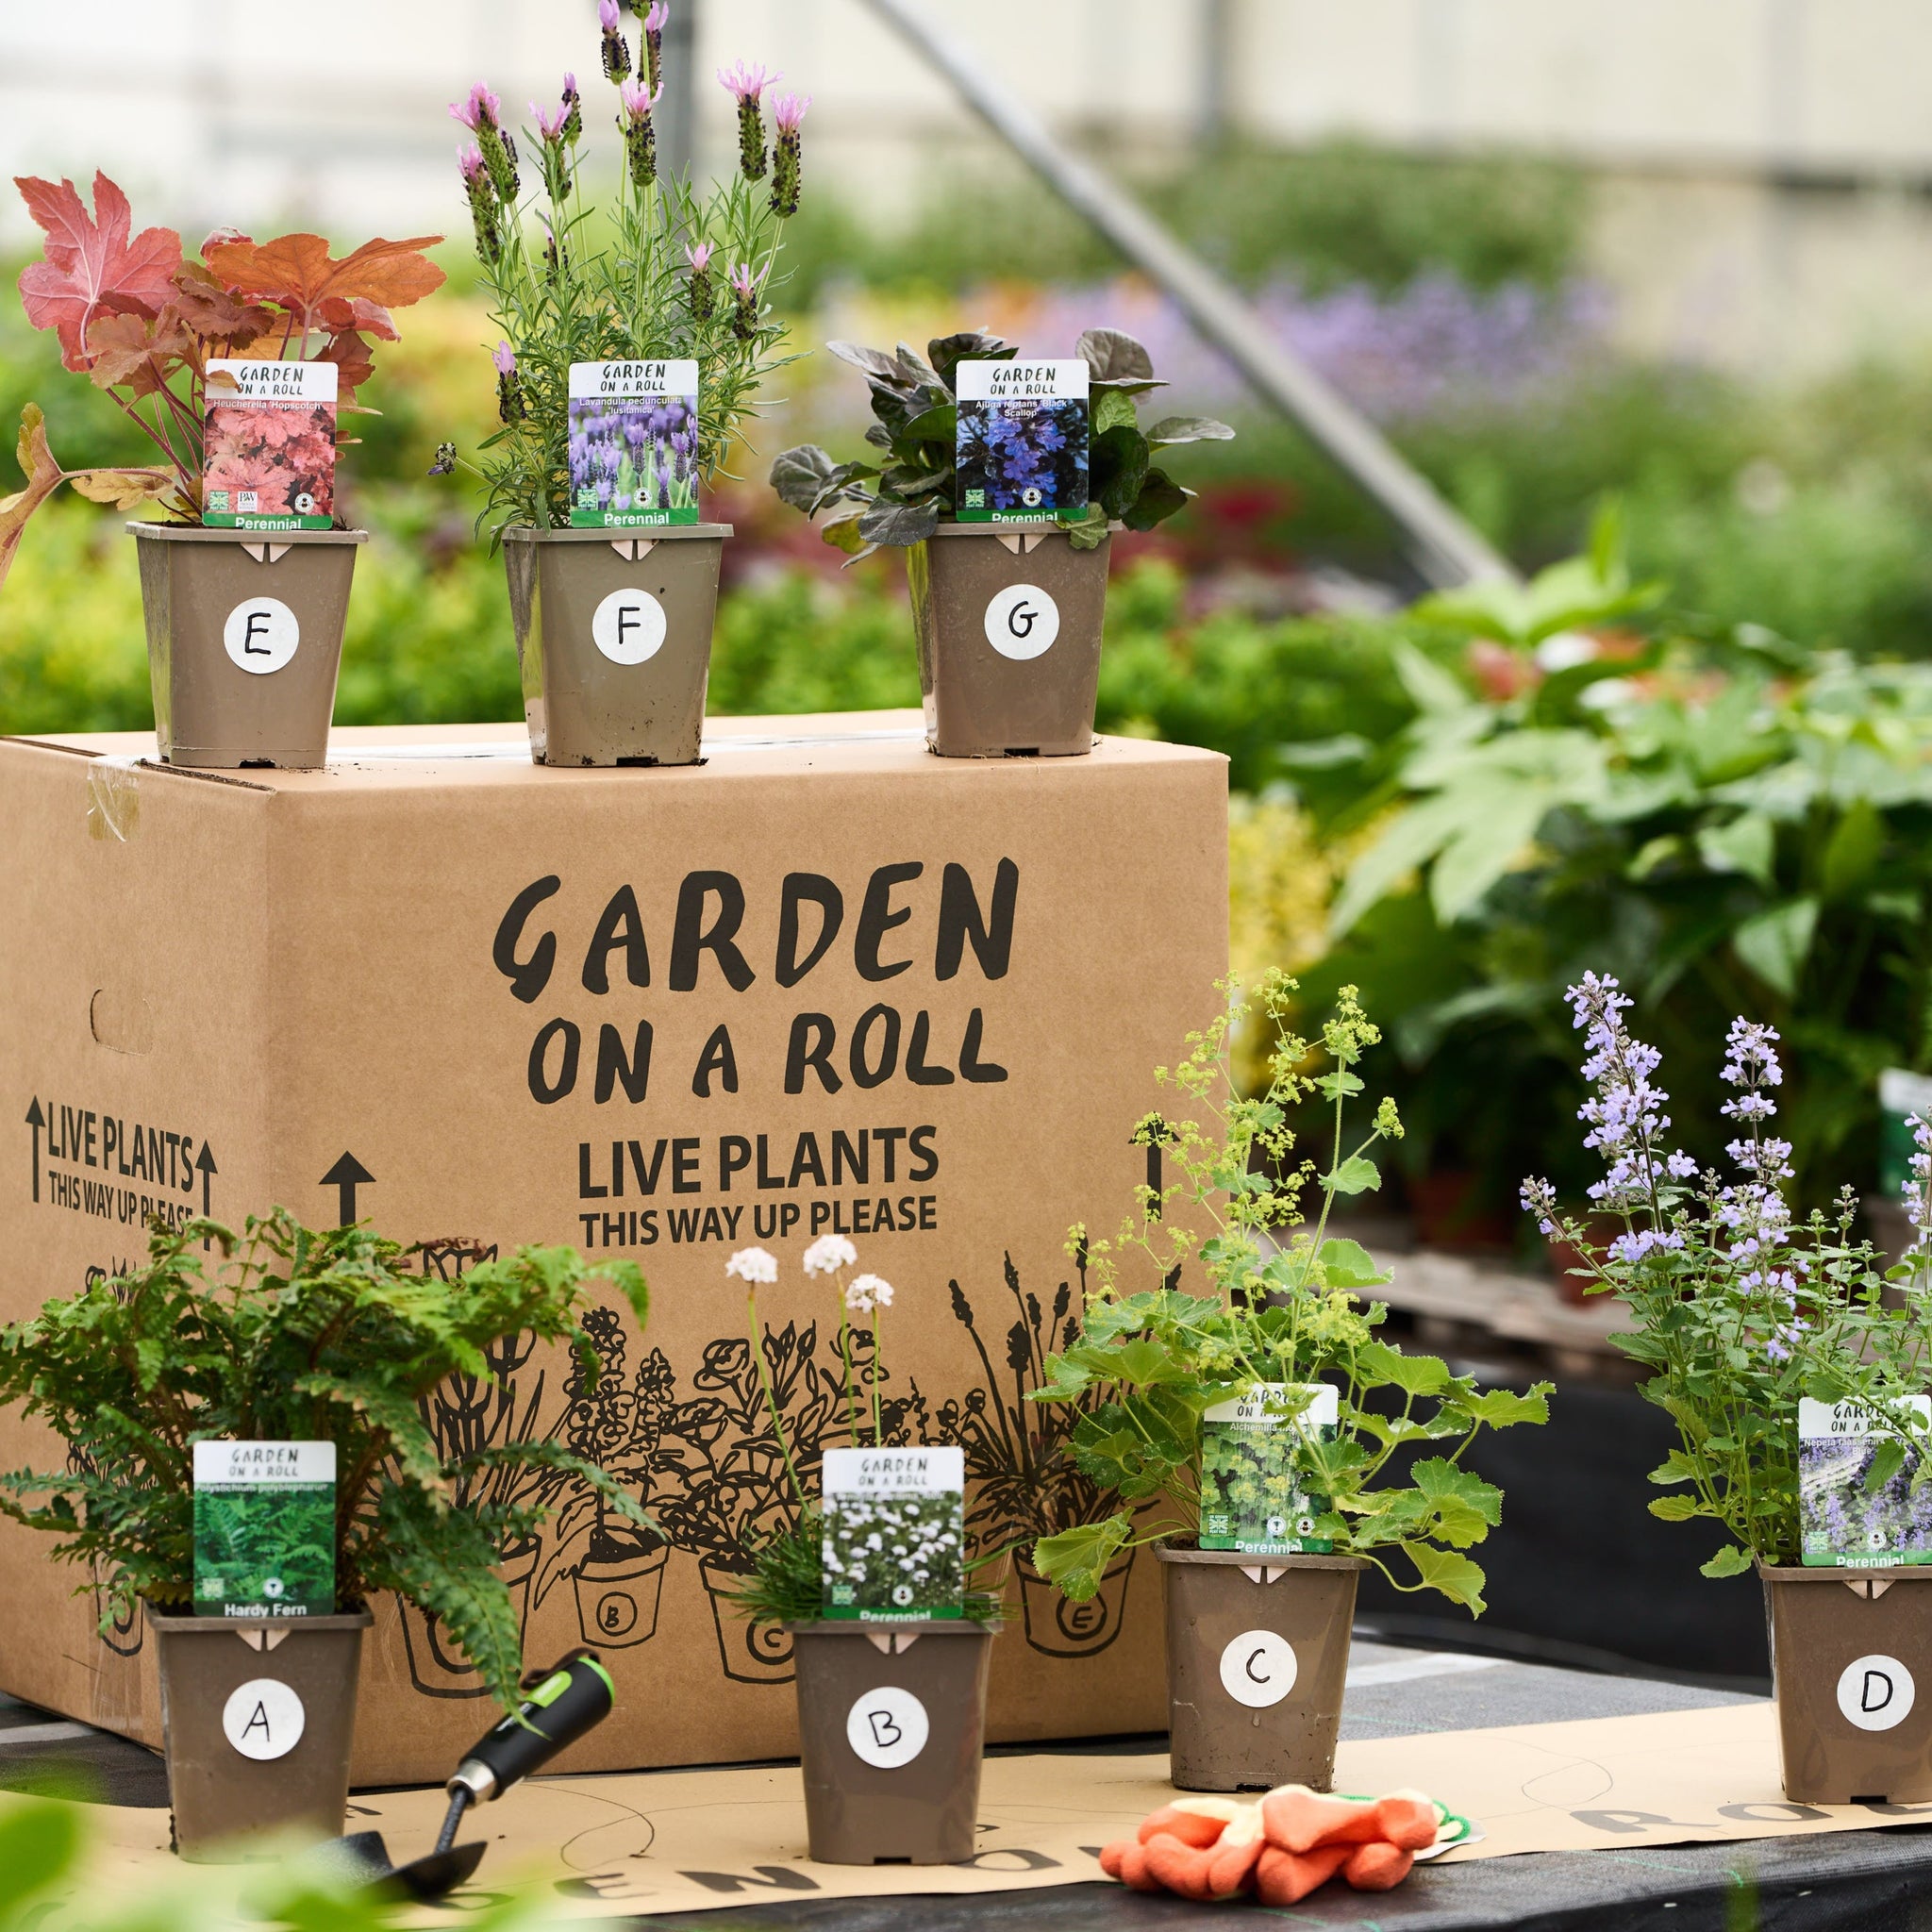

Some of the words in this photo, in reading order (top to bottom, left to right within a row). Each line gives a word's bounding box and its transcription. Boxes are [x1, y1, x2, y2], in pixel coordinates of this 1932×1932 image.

[241, 366, 304, 382] GARDEN
[603, 363, 666, 379] GARDEN
[992, 368, 1056, 382] GARDEN
[237, 384, 253, 394] ON
[259, 385, 266, 394] A
[273, 384, 303, 395] ROLL
[601, 380, 616, 391] ON
[623, 382, 629, 391] A
[636, 380, 666, 391] ROLL
[991, 384, 1006, 395] ON
[1012, 386, 1019, 394] A
[1025, 384, 1056, 394] ROLL
[213, 399, 267, 409] Heucherella
[579, 398, 626, 407] Lavandula
[975, 400, 1002, 409] Ajuga
[1004, 400, 1038, 409] reptans
[235, 517, 302, 530] Perennial
[604, 512, 670, 525] Perennial
[619, 607, 641, 644] F
[1008, 601, 1039, 638] G
[245, 612, 271, 656] E
[492, 857, 1019, 1004] GARDEN
[527, 1017, 654, 1105] ON
[691, 1024, 739, 1098] A
[784, 1003, 1008, 1095] ROLL
[48, 1101, 97, 1167] LIVE
[104, 1116, 193, 1192] PLANTS
[578, 1137, 701, 1199] LIVE
[719, 1125, 940, 1192] PLANTS
[48, 1170, 80, 1210] THIS
[83, 1179, 114, 1220] WAY
[117, 1189, 137, 1224] UP
[579, 1209, 659, 1248] THIS
[666, 1206, 744, 1242] WAY
[754, 1203, 801, 1240] UP
[810, 1195, 938, 1236] PLEASE
[1238, 1406, 1253, 1417] ON
[1230, 1423, 1277, 1431] Alchemilla
[1831, 1421, 1846, 1432] ON
[1854, 1423, 1859, 1431] A
[1804, 1438, 1836, 1448] Nepeta
[232, 1448, 299, 1463] GARDEN
[229, 1465, 245, 1477] ON
[253, 1468, 259, 1476] A
[267, 1466, 299, 1477] ROLL
[861, 1458, 928, 1473] GARDEN
[858, 1475, 874, 1487] ON
[883, 1477, 889, 1486] A
[896, 1475, 927, 1486] ROLL
[1235, 1541, 1303, 1554] Perennial
[1836, 1556, 1905, 1568] Perennial
[225, 1604, 269, 1618] Hardy
[274, 1603, 307, 1616] Fern
[605, 1606, 619, 1627] B
[1072, 1606, 1093, 1628] E
[764, 1628, 785, 1648] C
[1246, 1648, 1271, 1683] C
[1861, 1671, 1893, 1712] D
[242, 1700, 270, 1742] A
[868, 1710, 902, 1747] B
